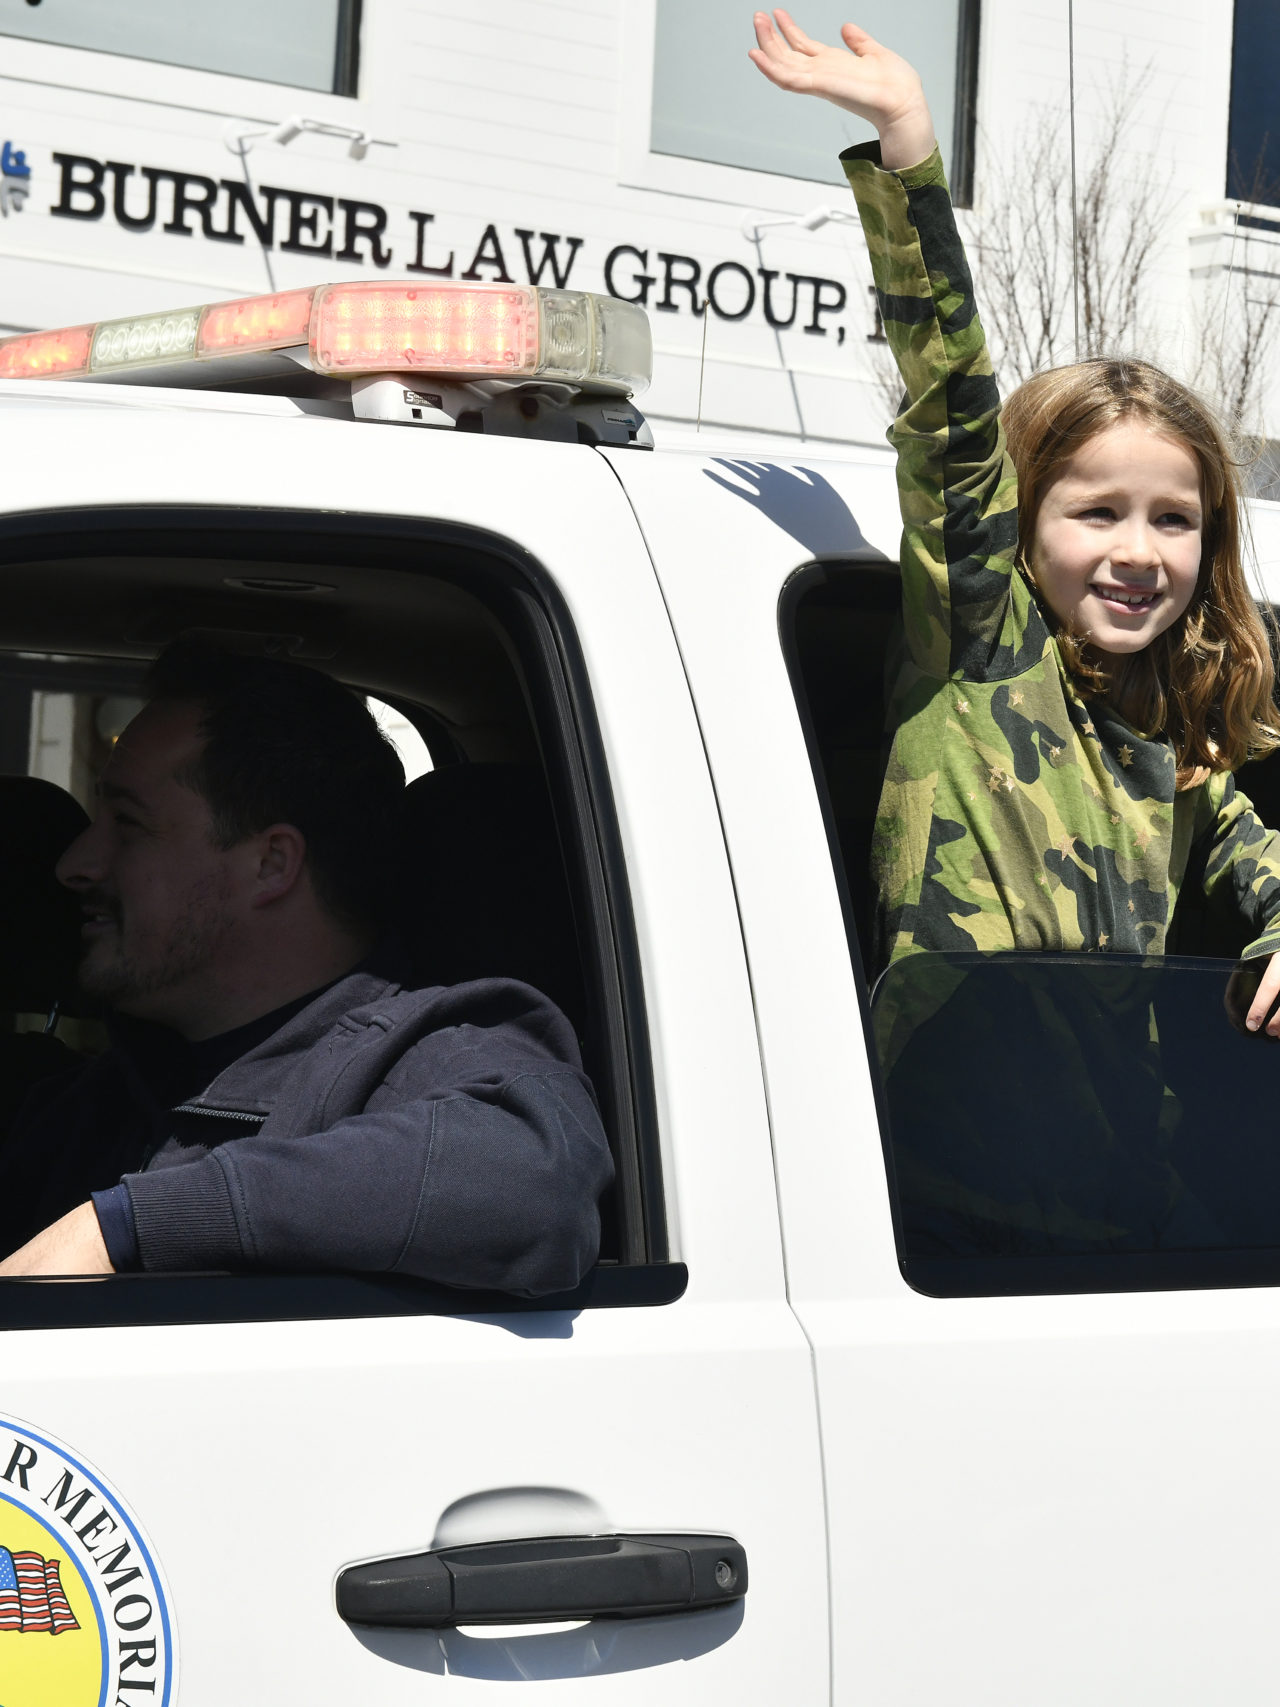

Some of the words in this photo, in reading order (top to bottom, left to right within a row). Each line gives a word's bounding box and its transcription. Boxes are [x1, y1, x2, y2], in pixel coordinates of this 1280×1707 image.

[51, 152, 392, 269] BURNER
[406, 211, 584, 289] LAW
[604, 245, 847, 346] GROUP,
[40, 1467, 157, 1707] MEMORI
